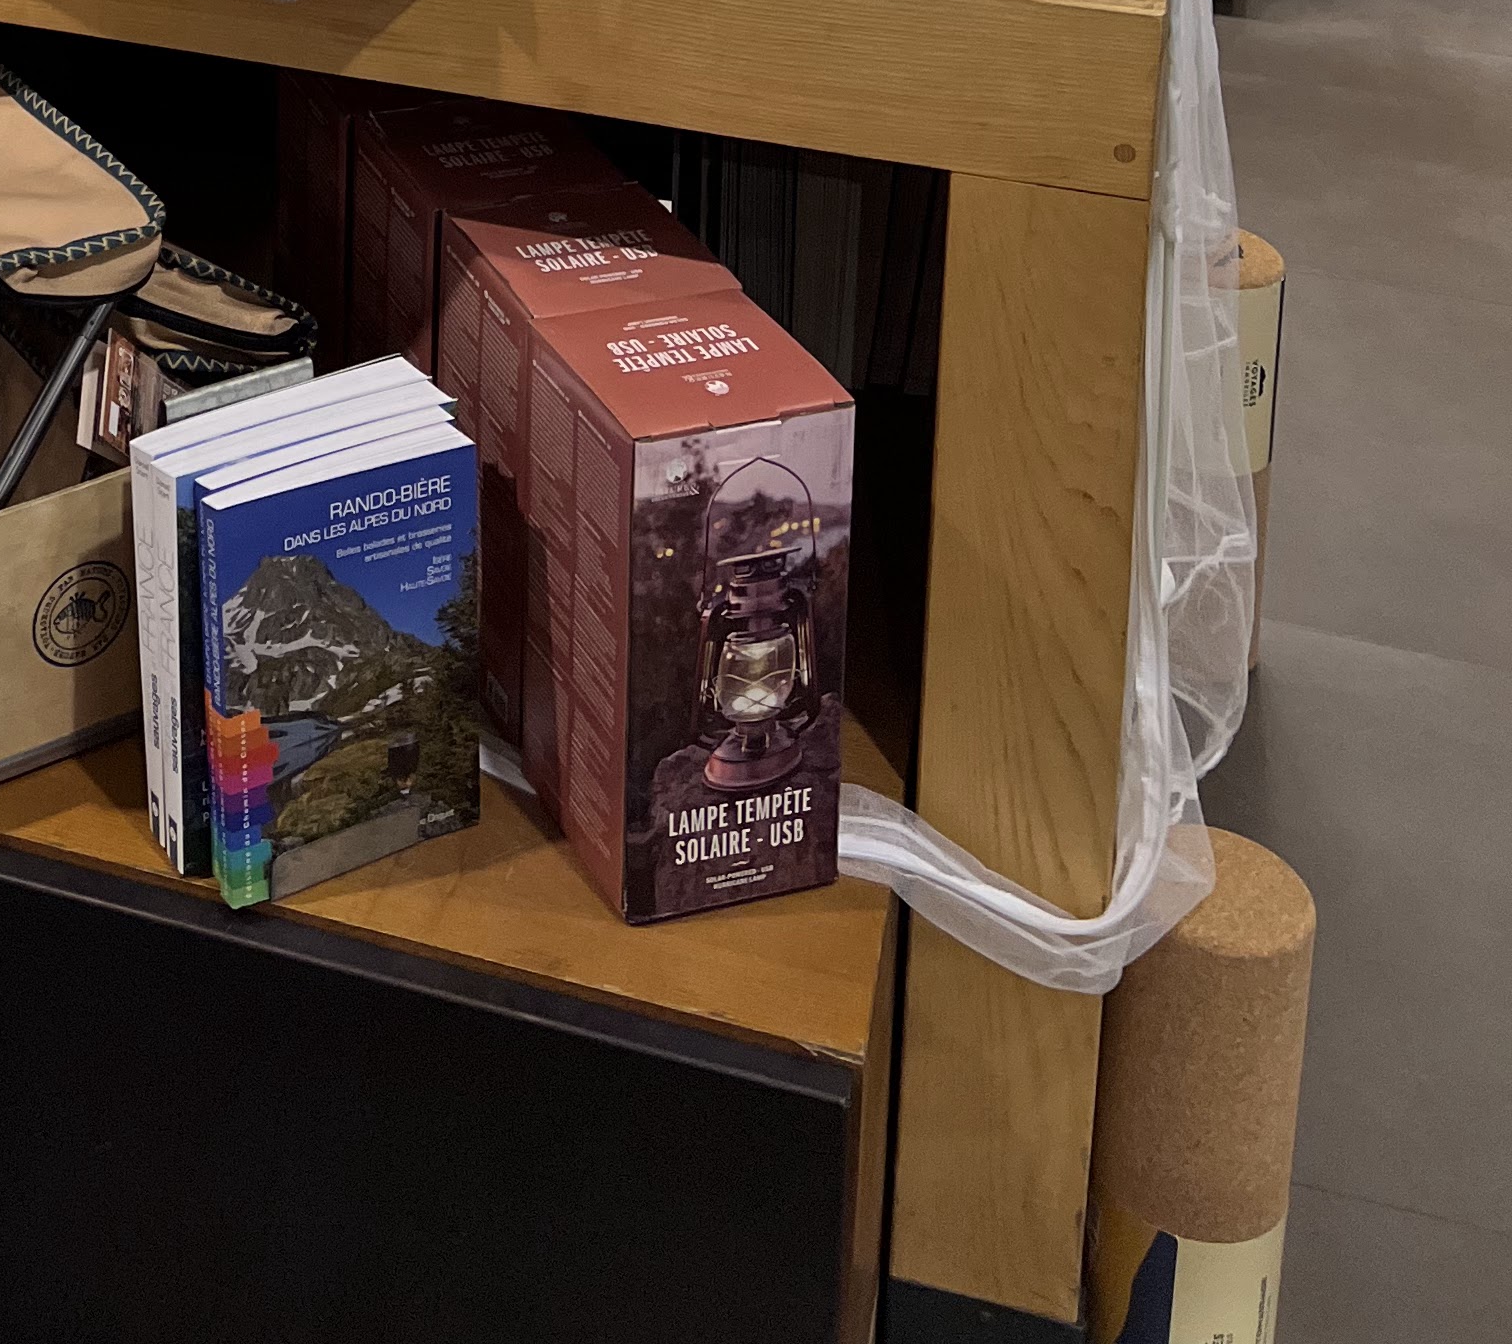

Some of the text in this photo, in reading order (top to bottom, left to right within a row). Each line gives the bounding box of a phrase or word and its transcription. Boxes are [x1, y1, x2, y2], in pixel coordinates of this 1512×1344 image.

[422, 138, 478, 157] LAMPE
[438, 145, 554, 169] SOLAIRE USB
[515, 228, 652, 260] LAMPE TEMPÊTE
[535, 244, 658, 273] SOLAIRE USB
[606, 323, 737, 356] SOLAIRE USB
[612, 336, 760, 373] LAMPE TEMPÊTE
[1249, 359, 1258, 407] VOYAGES
[330, 474, 451, 521] RANDO-BIÈRE
[206, 518, 215, 556] NORD
[284, 496, 452, 552] DANS LES ALPES DU NORD
[363, 537, 396, 552] balades
[397, 533, 407, 544] et
[411, 541, 423, 551] de
[207, 559, 216, 578] DU
[208, 581, 218, 618] ALPES
[137, 526, 161, 750] sauvages FRANCE
[157, 546, 180, 774] sauvages FRANCE
[242, 788, 250, 829] Chemin
[668, 785, 813, 839] LAMPE TEMPÊTE
[244, 833, 251, 847] du
[675, 817, 804, 865] SOLAIRE USB
